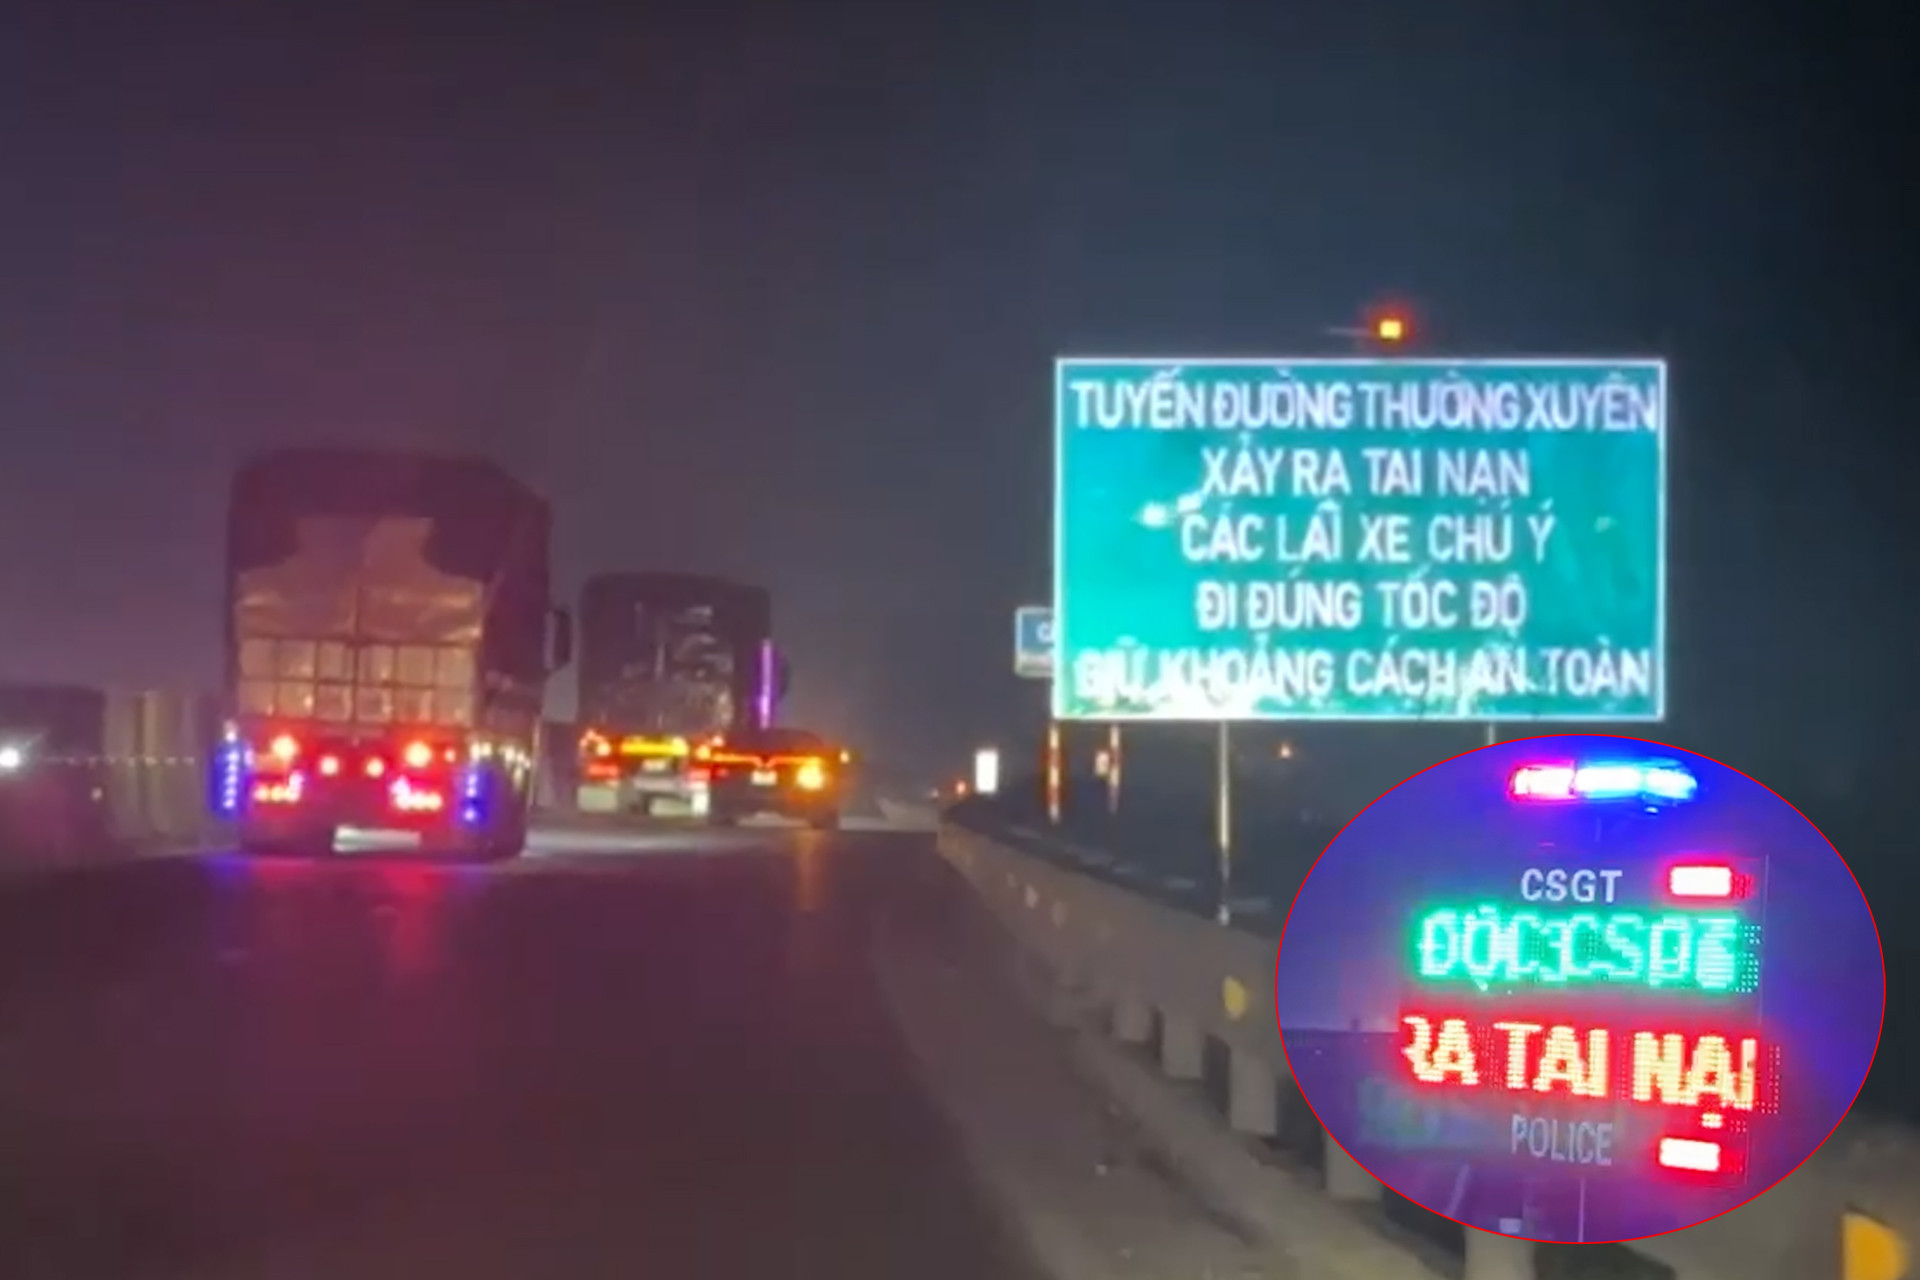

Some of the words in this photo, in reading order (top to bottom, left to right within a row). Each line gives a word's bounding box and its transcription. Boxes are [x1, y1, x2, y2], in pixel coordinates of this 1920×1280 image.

[1291, 447, 1351, 495] RA
[1362, 447, 1422, 495] TAI
[1181, 500, 1264, 561] CÁC
[1357, 513, 1411, 562] XE
[1428, 498, 1513, 562] CHÚ
[1527, 497, 1555, 562] Ý
[1195, 580, 1238, 629] ĐI
[1247, 567, 1363, 630] ĐÚNG
[1346, 634, 1455, 697] CÁCH
[1539, 634, 1650, 698] TOÀN
[1521, 868, 1623, 903] CSGT
[1494, 1022, 1608, 1097] TAI
[1511, 1114, 1613, 1166] POLICE
